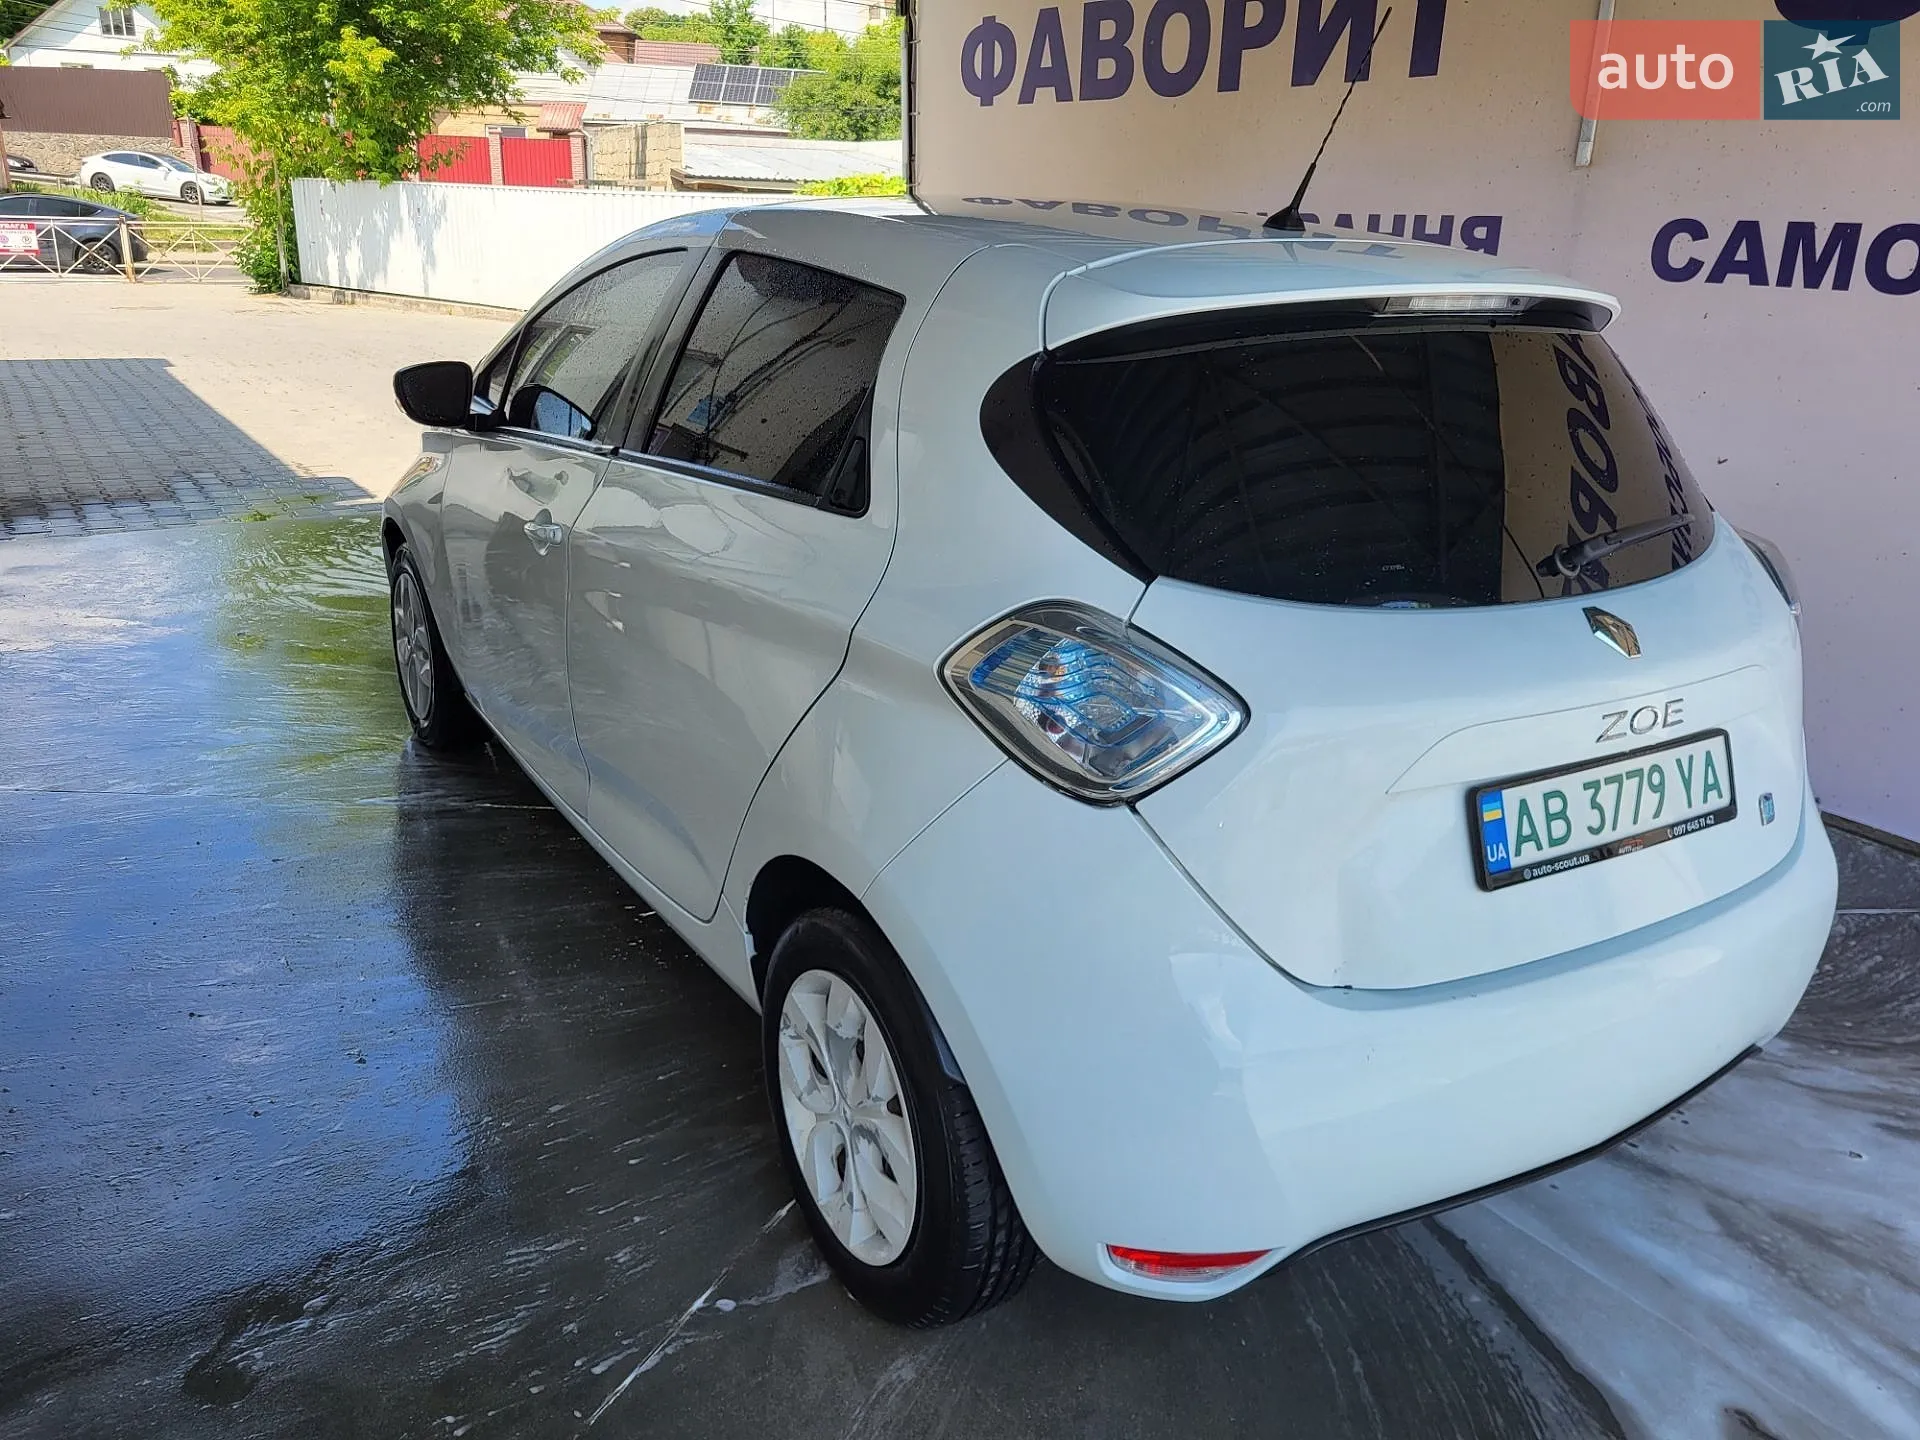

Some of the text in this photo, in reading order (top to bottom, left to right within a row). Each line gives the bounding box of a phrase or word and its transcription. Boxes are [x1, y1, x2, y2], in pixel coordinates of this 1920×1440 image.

[1596, 698, 1684, 743] ZOE
[1514, 750, 1723, 857] AB 3779 YA
[1673, 823, 1687, 836] 097
[1487, 842, 1507, 862] UA
[1532, 853, 1590, 877] auto-scout.ua
